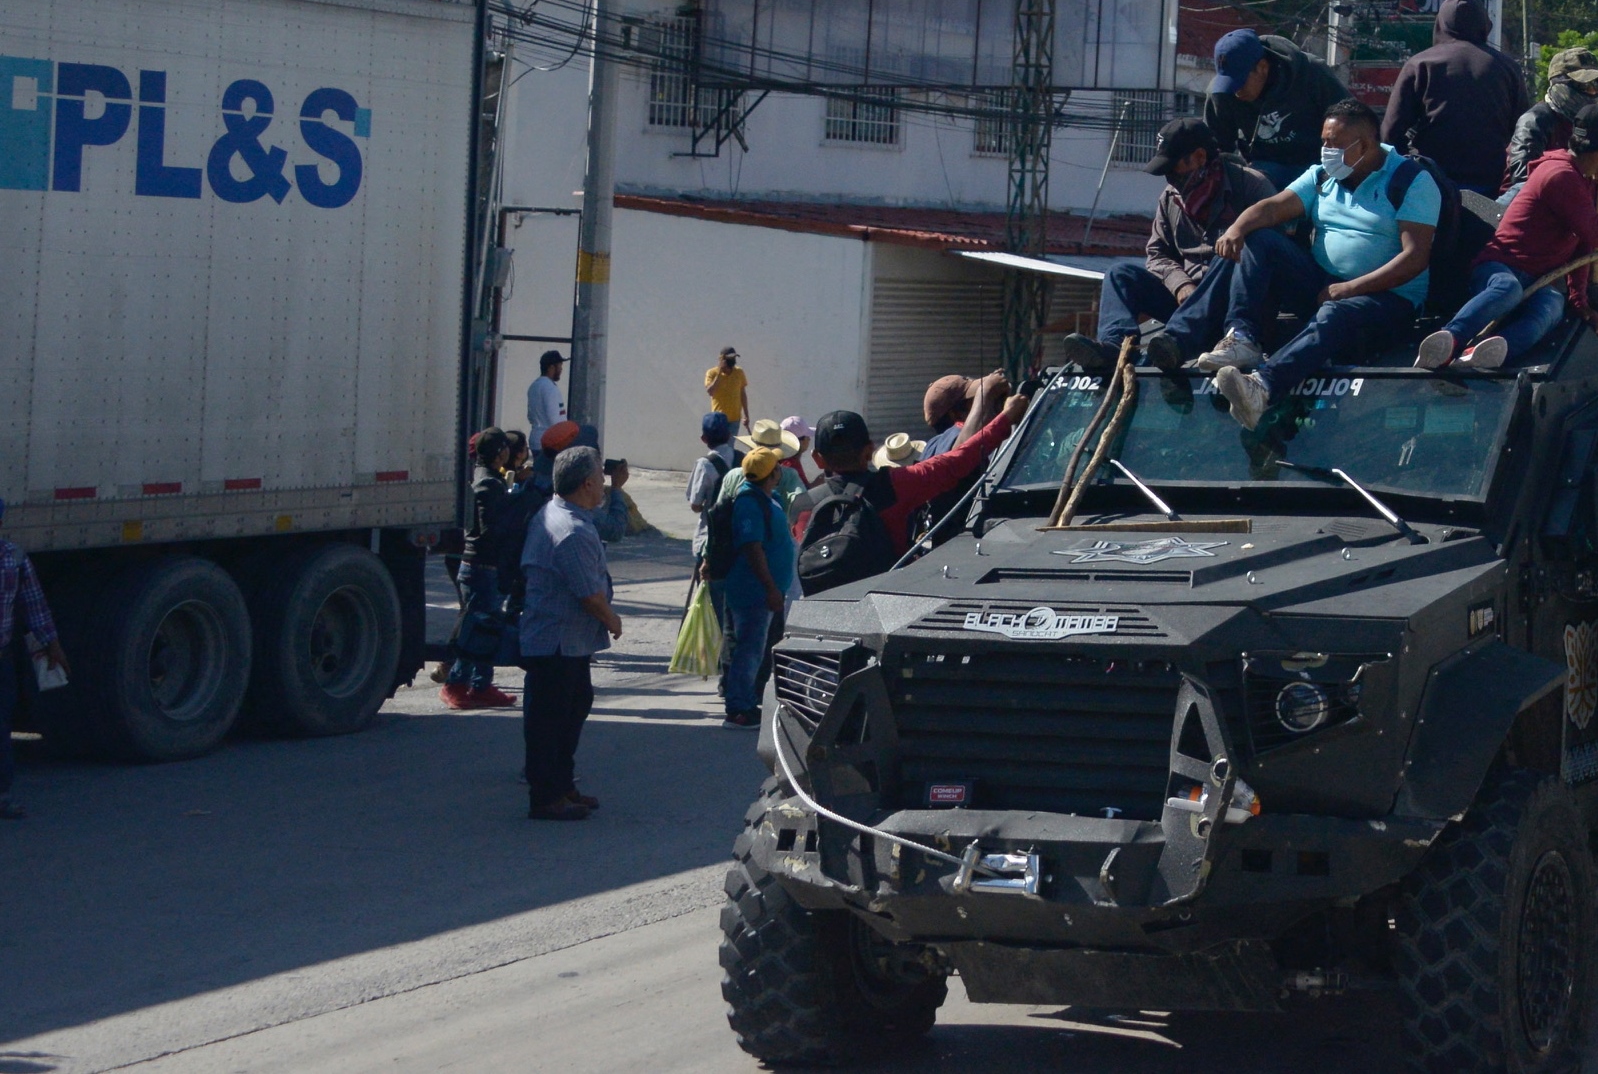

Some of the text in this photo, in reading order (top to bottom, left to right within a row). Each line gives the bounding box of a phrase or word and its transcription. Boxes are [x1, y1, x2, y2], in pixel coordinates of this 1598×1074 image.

[52, 62, 363, 210] PL&S
[963, 612, 1119, 631] BLACK MAMBA
